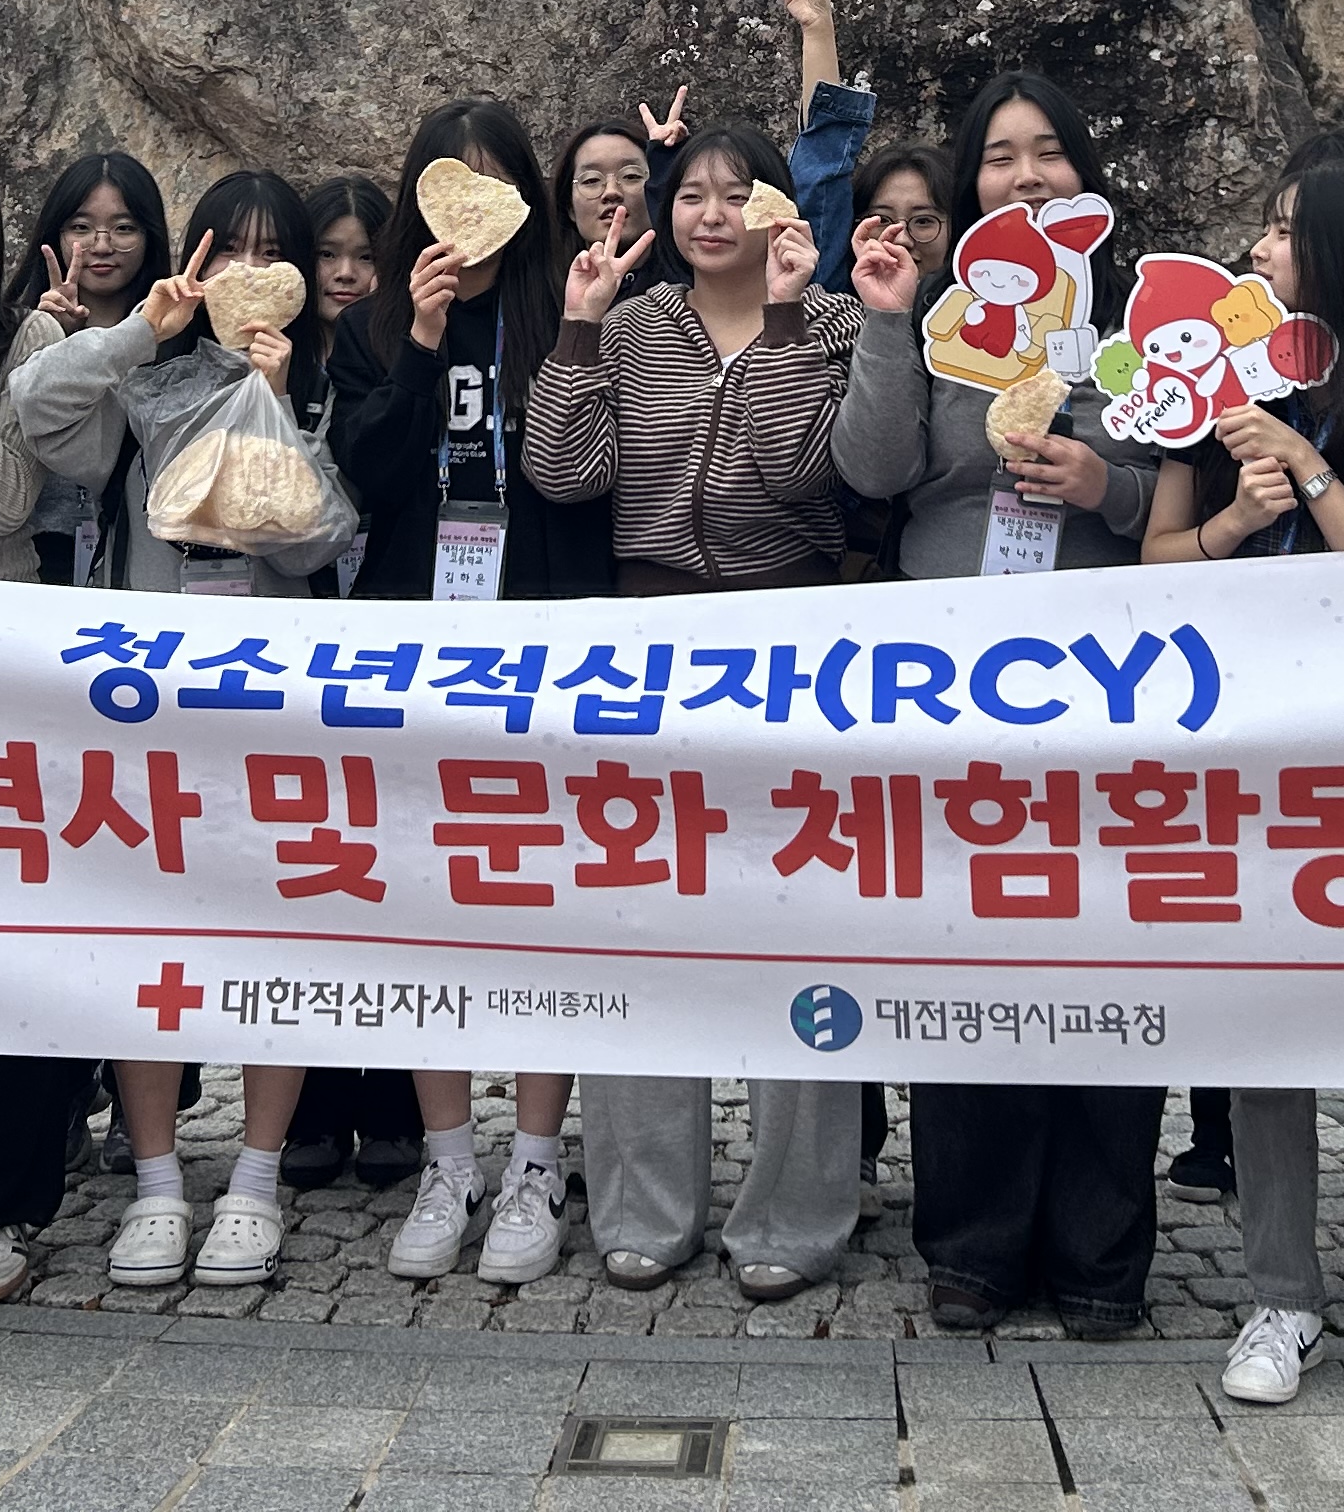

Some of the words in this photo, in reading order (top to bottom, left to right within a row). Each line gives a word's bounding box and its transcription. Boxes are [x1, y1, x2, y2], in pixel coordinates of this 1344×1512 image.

[1133, 386, 1186, 436] Friends
[59, 622, 1222, 734] 청소년적십자(RCY)
[244, 753, 387, 904] 및
[432, 758, 728, 907] 문화
[221, 976, 473, 1029] 대한적십자사
[487, 987, 631, 1020] 대전세종지사
[875, 998, 1167, 1046] 대전광역시교육청
